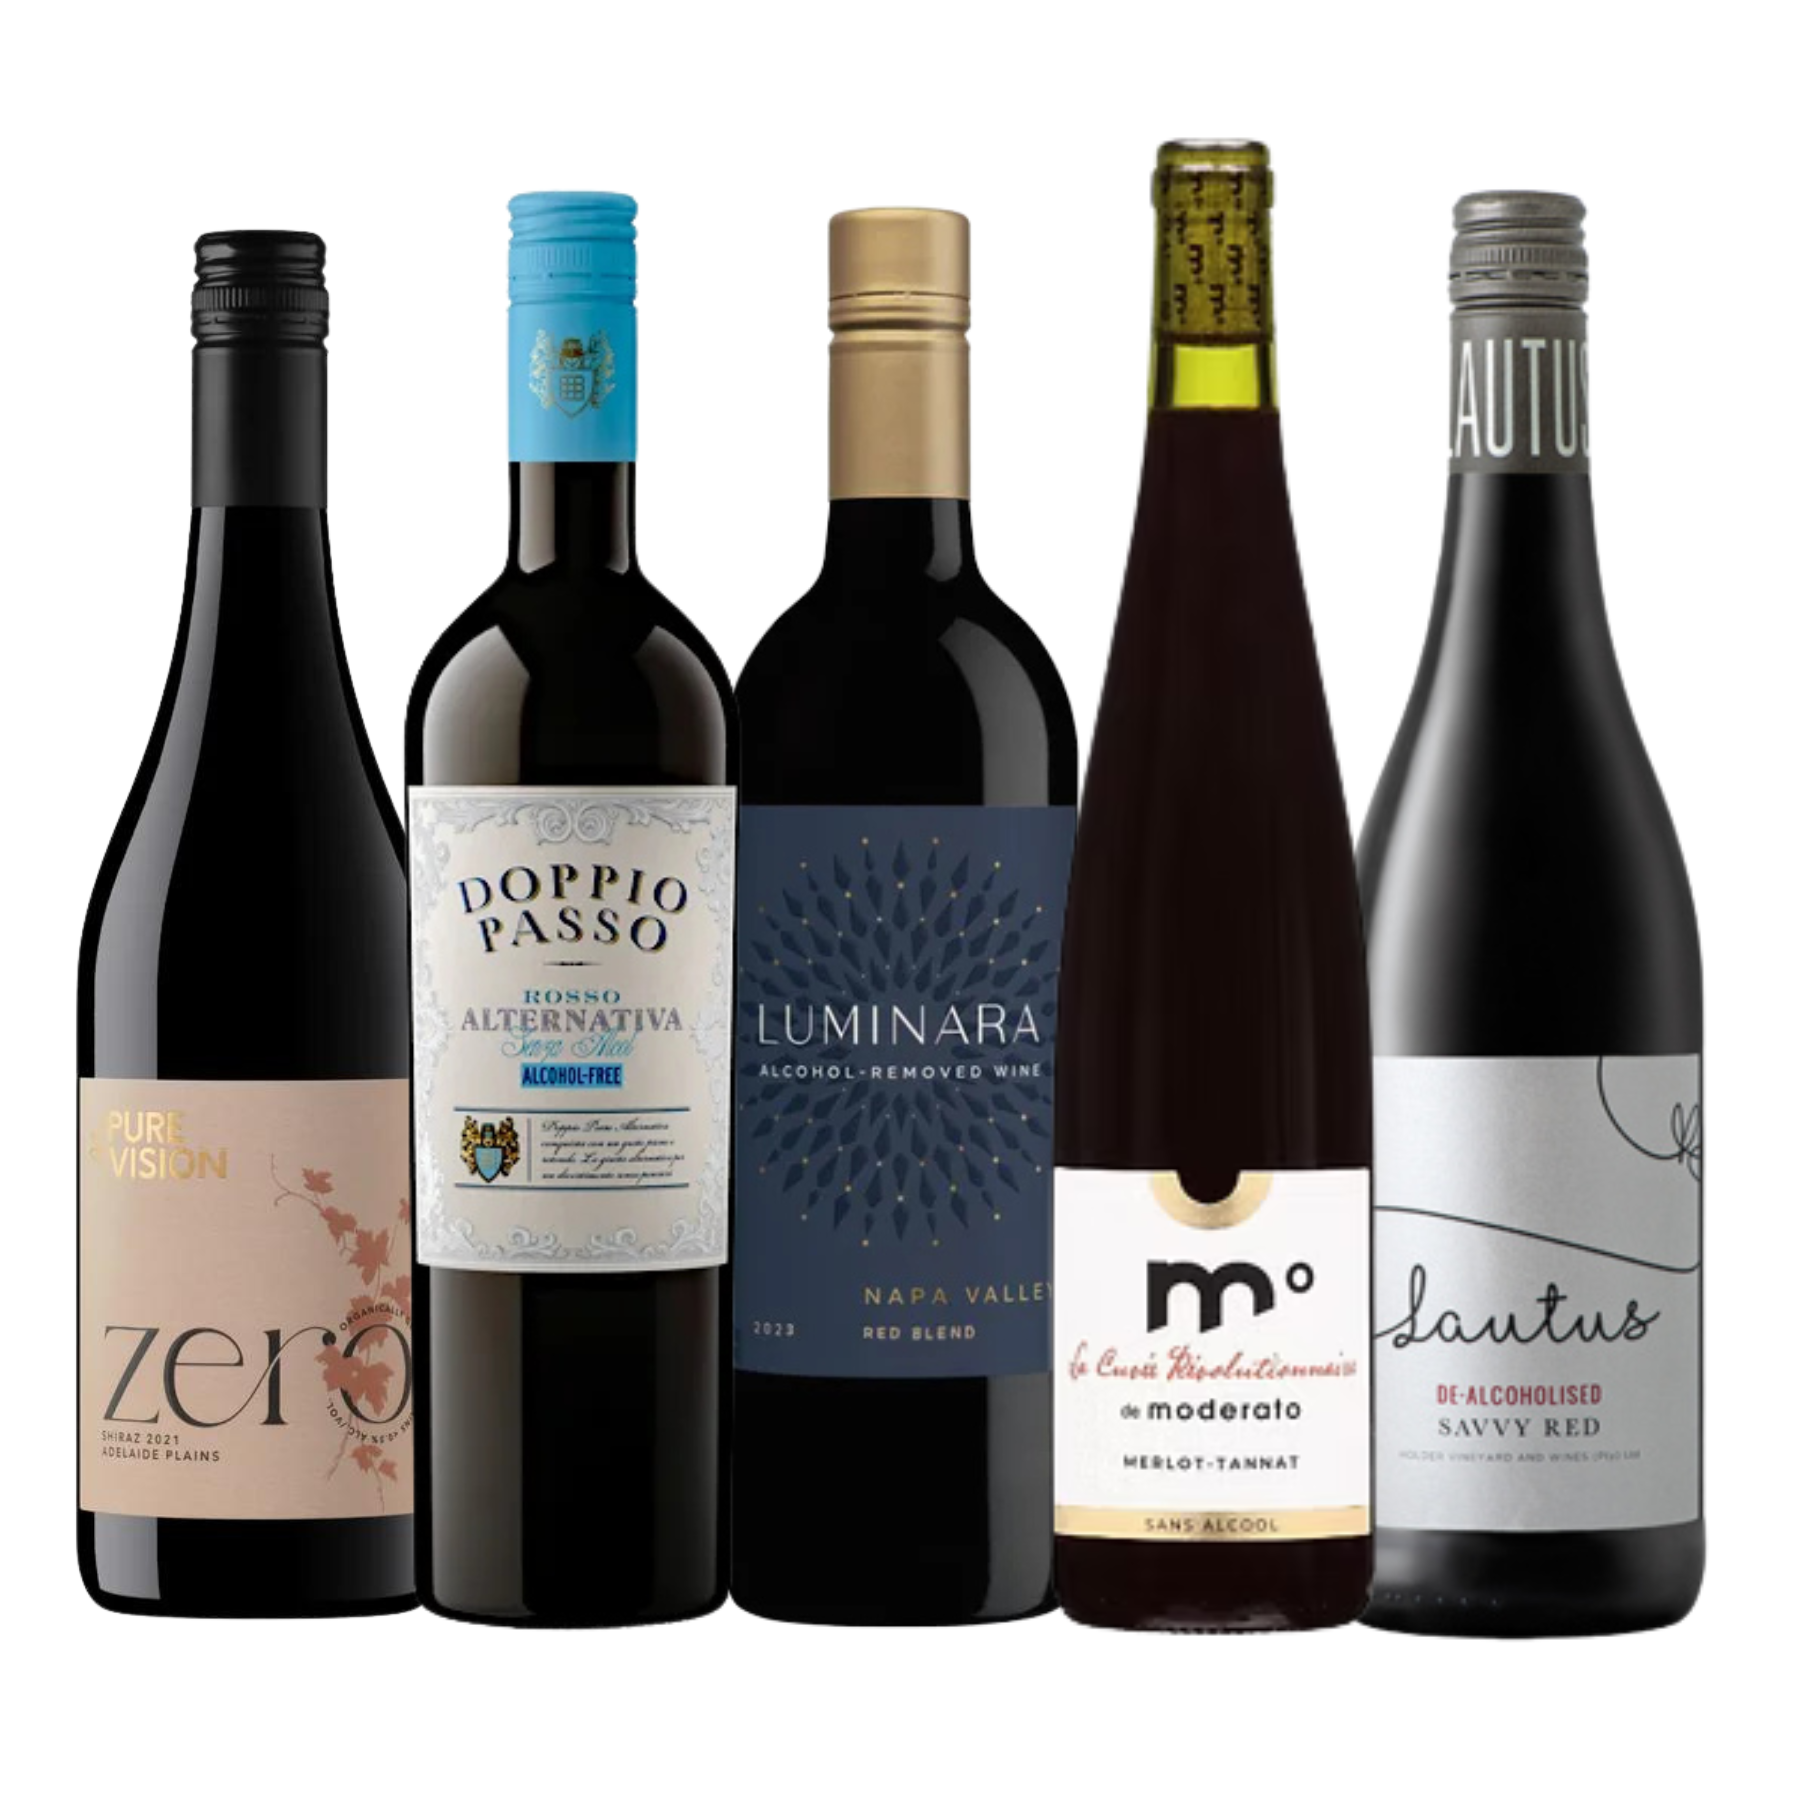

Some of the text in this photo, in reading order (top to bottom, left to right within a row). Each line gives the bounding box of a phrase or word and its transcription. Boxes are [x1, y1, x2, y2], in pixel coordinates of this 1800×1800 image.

[458, 863, 688, 914] DOPPIO
[478, 906, 668, 954] PASSO
[524, 989, 621, 1005] ROSSO
[461, 1007, 683, 1033] ALTERNATIVA
[759, 1003, 1040, 1045] LUMINARA
[522, 1066, 622, 1085] ALCOHOL-FREE
[759, 1062, 1041, 1079] ALCOHOL-REMOVED WINE
[108, 1110, 191, 1144] PURE
[109, 1147, 228, 1179] VISION
[864, 1286, 949, 1305] NAPA
[1391, 1263, 1661, 1348] Lautus
[753, 1321, 795, 1337] 2023
[863, 1325, 976, 1341] RED BLEND
[104, 1324, 413, 1429] zero
[1436, 1384, 1603, 1406] DE-ALCOHOLISED
[1120, 1398, 1302, 1421] de moderato
[101, 1430, 180, 1445] SHIRAZ 2021
[1438, 1417, 1601, 1438] SAVVY RED
[101, 1446, 221, 1462] ADELAIDE PLAINS
[1123, 1454, 1299, 1470] MERLOT-TANNAT
[1517, 1451, 1545, 1463] AND
[1549, 1451, 1589, 1463] WINES
[1144, 1517, 1279, 1533] SANS ALCOOL
